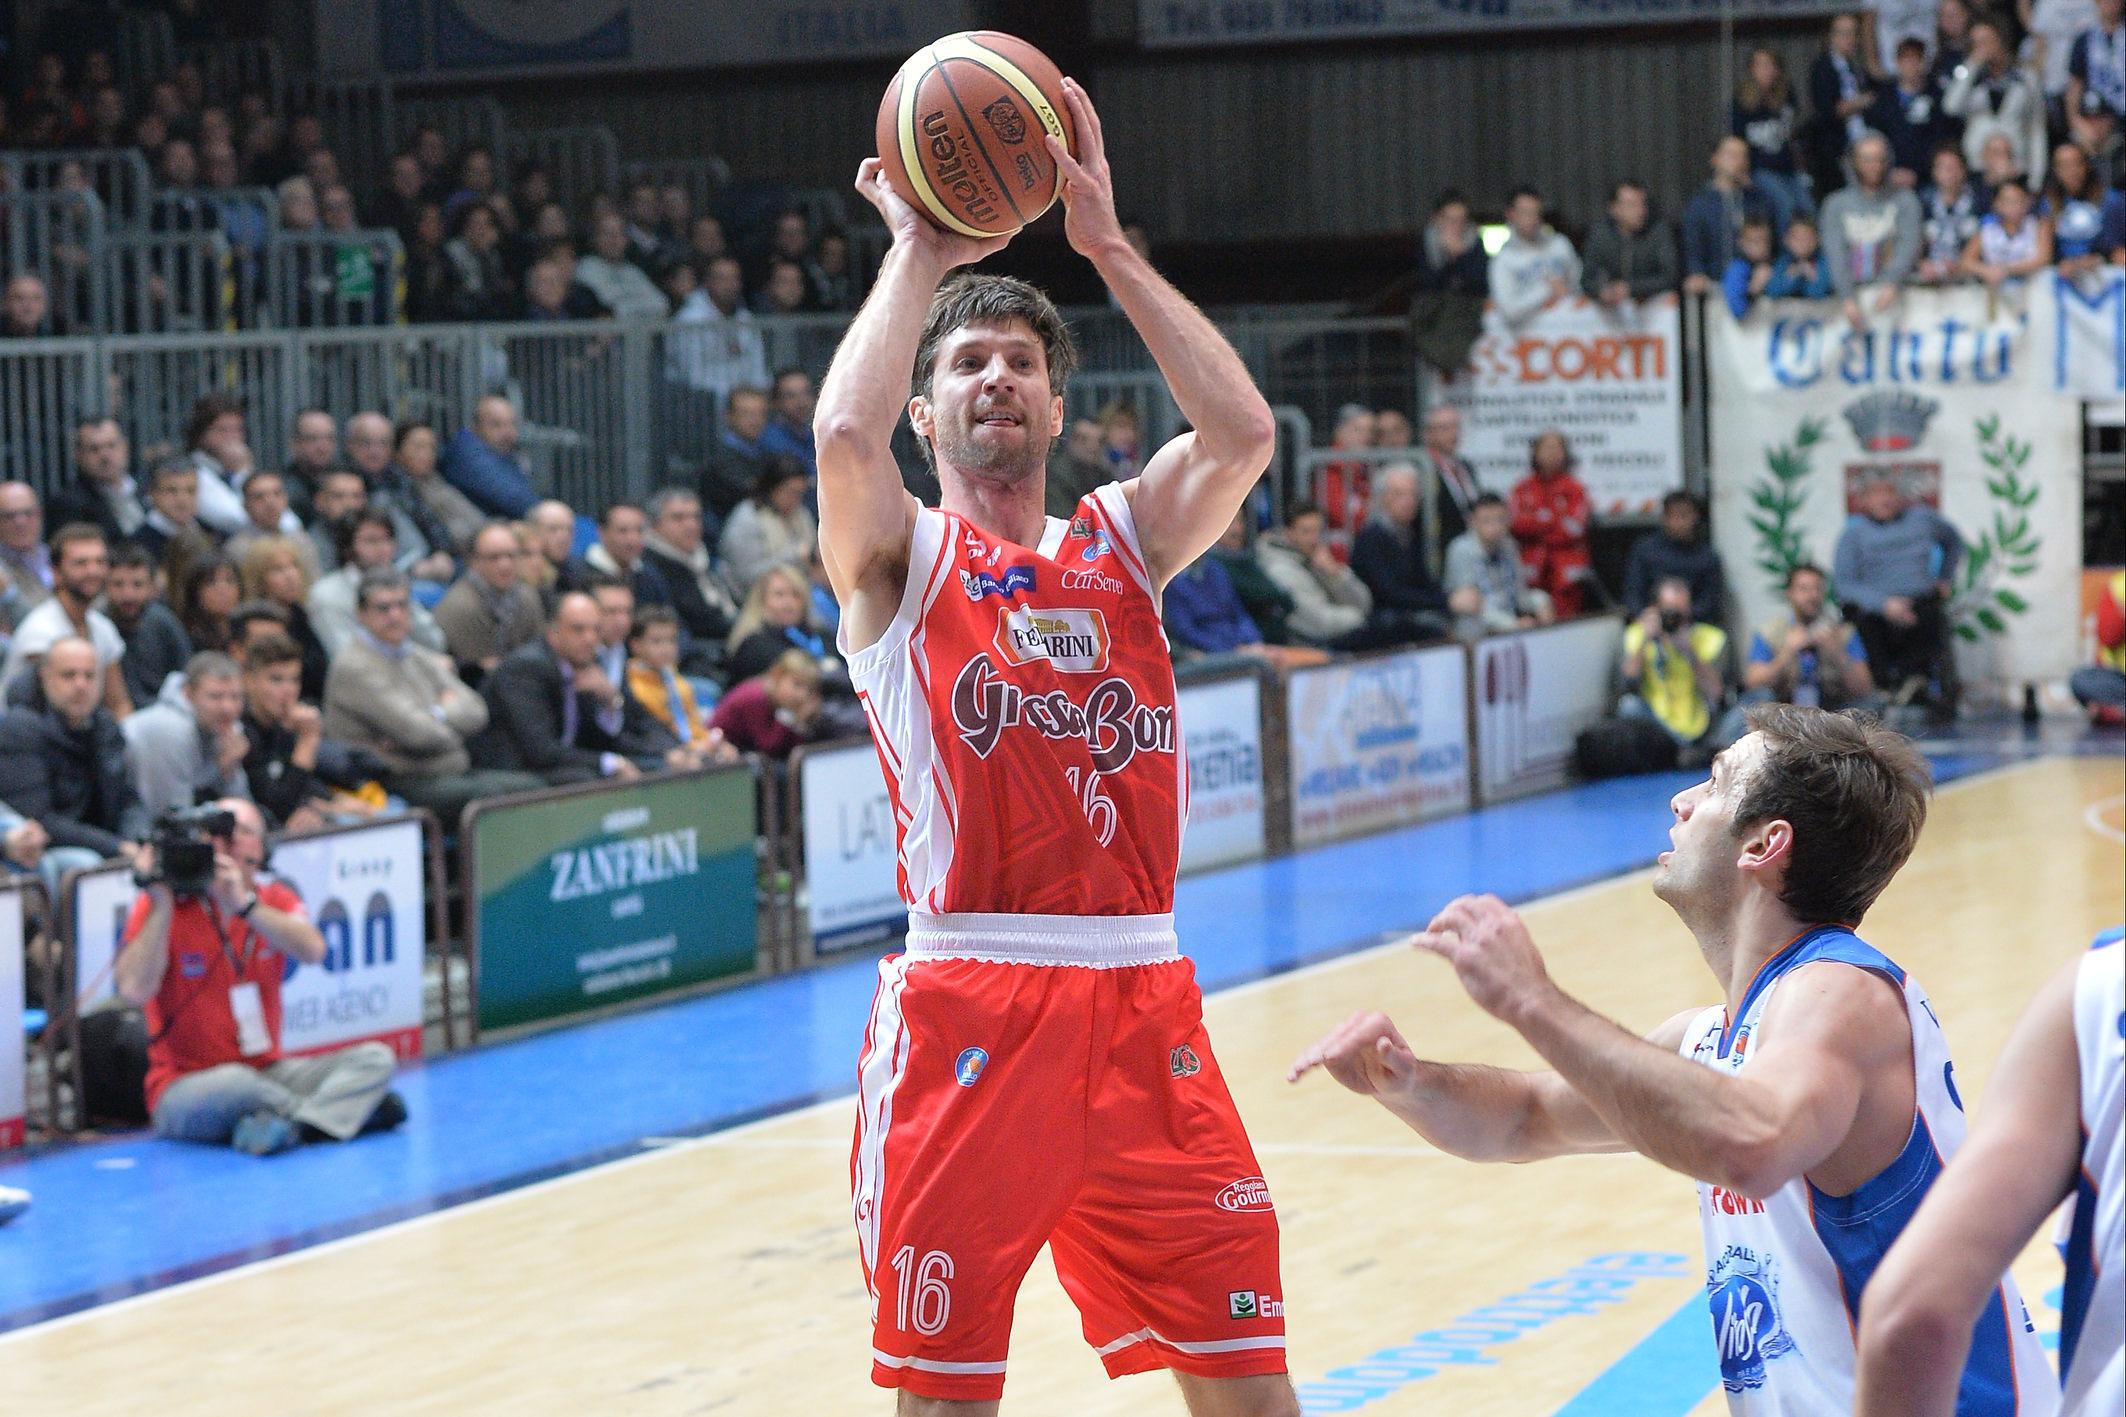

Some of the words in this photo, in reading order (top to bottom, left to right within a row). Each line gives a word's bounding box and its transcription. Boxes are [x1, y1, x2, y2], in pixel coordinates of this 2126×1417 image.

[923, 110, 1000, 224] molten
[957, 127, 998, 201] OFFICIAL
[891, 1244, 955, 1336] 16
